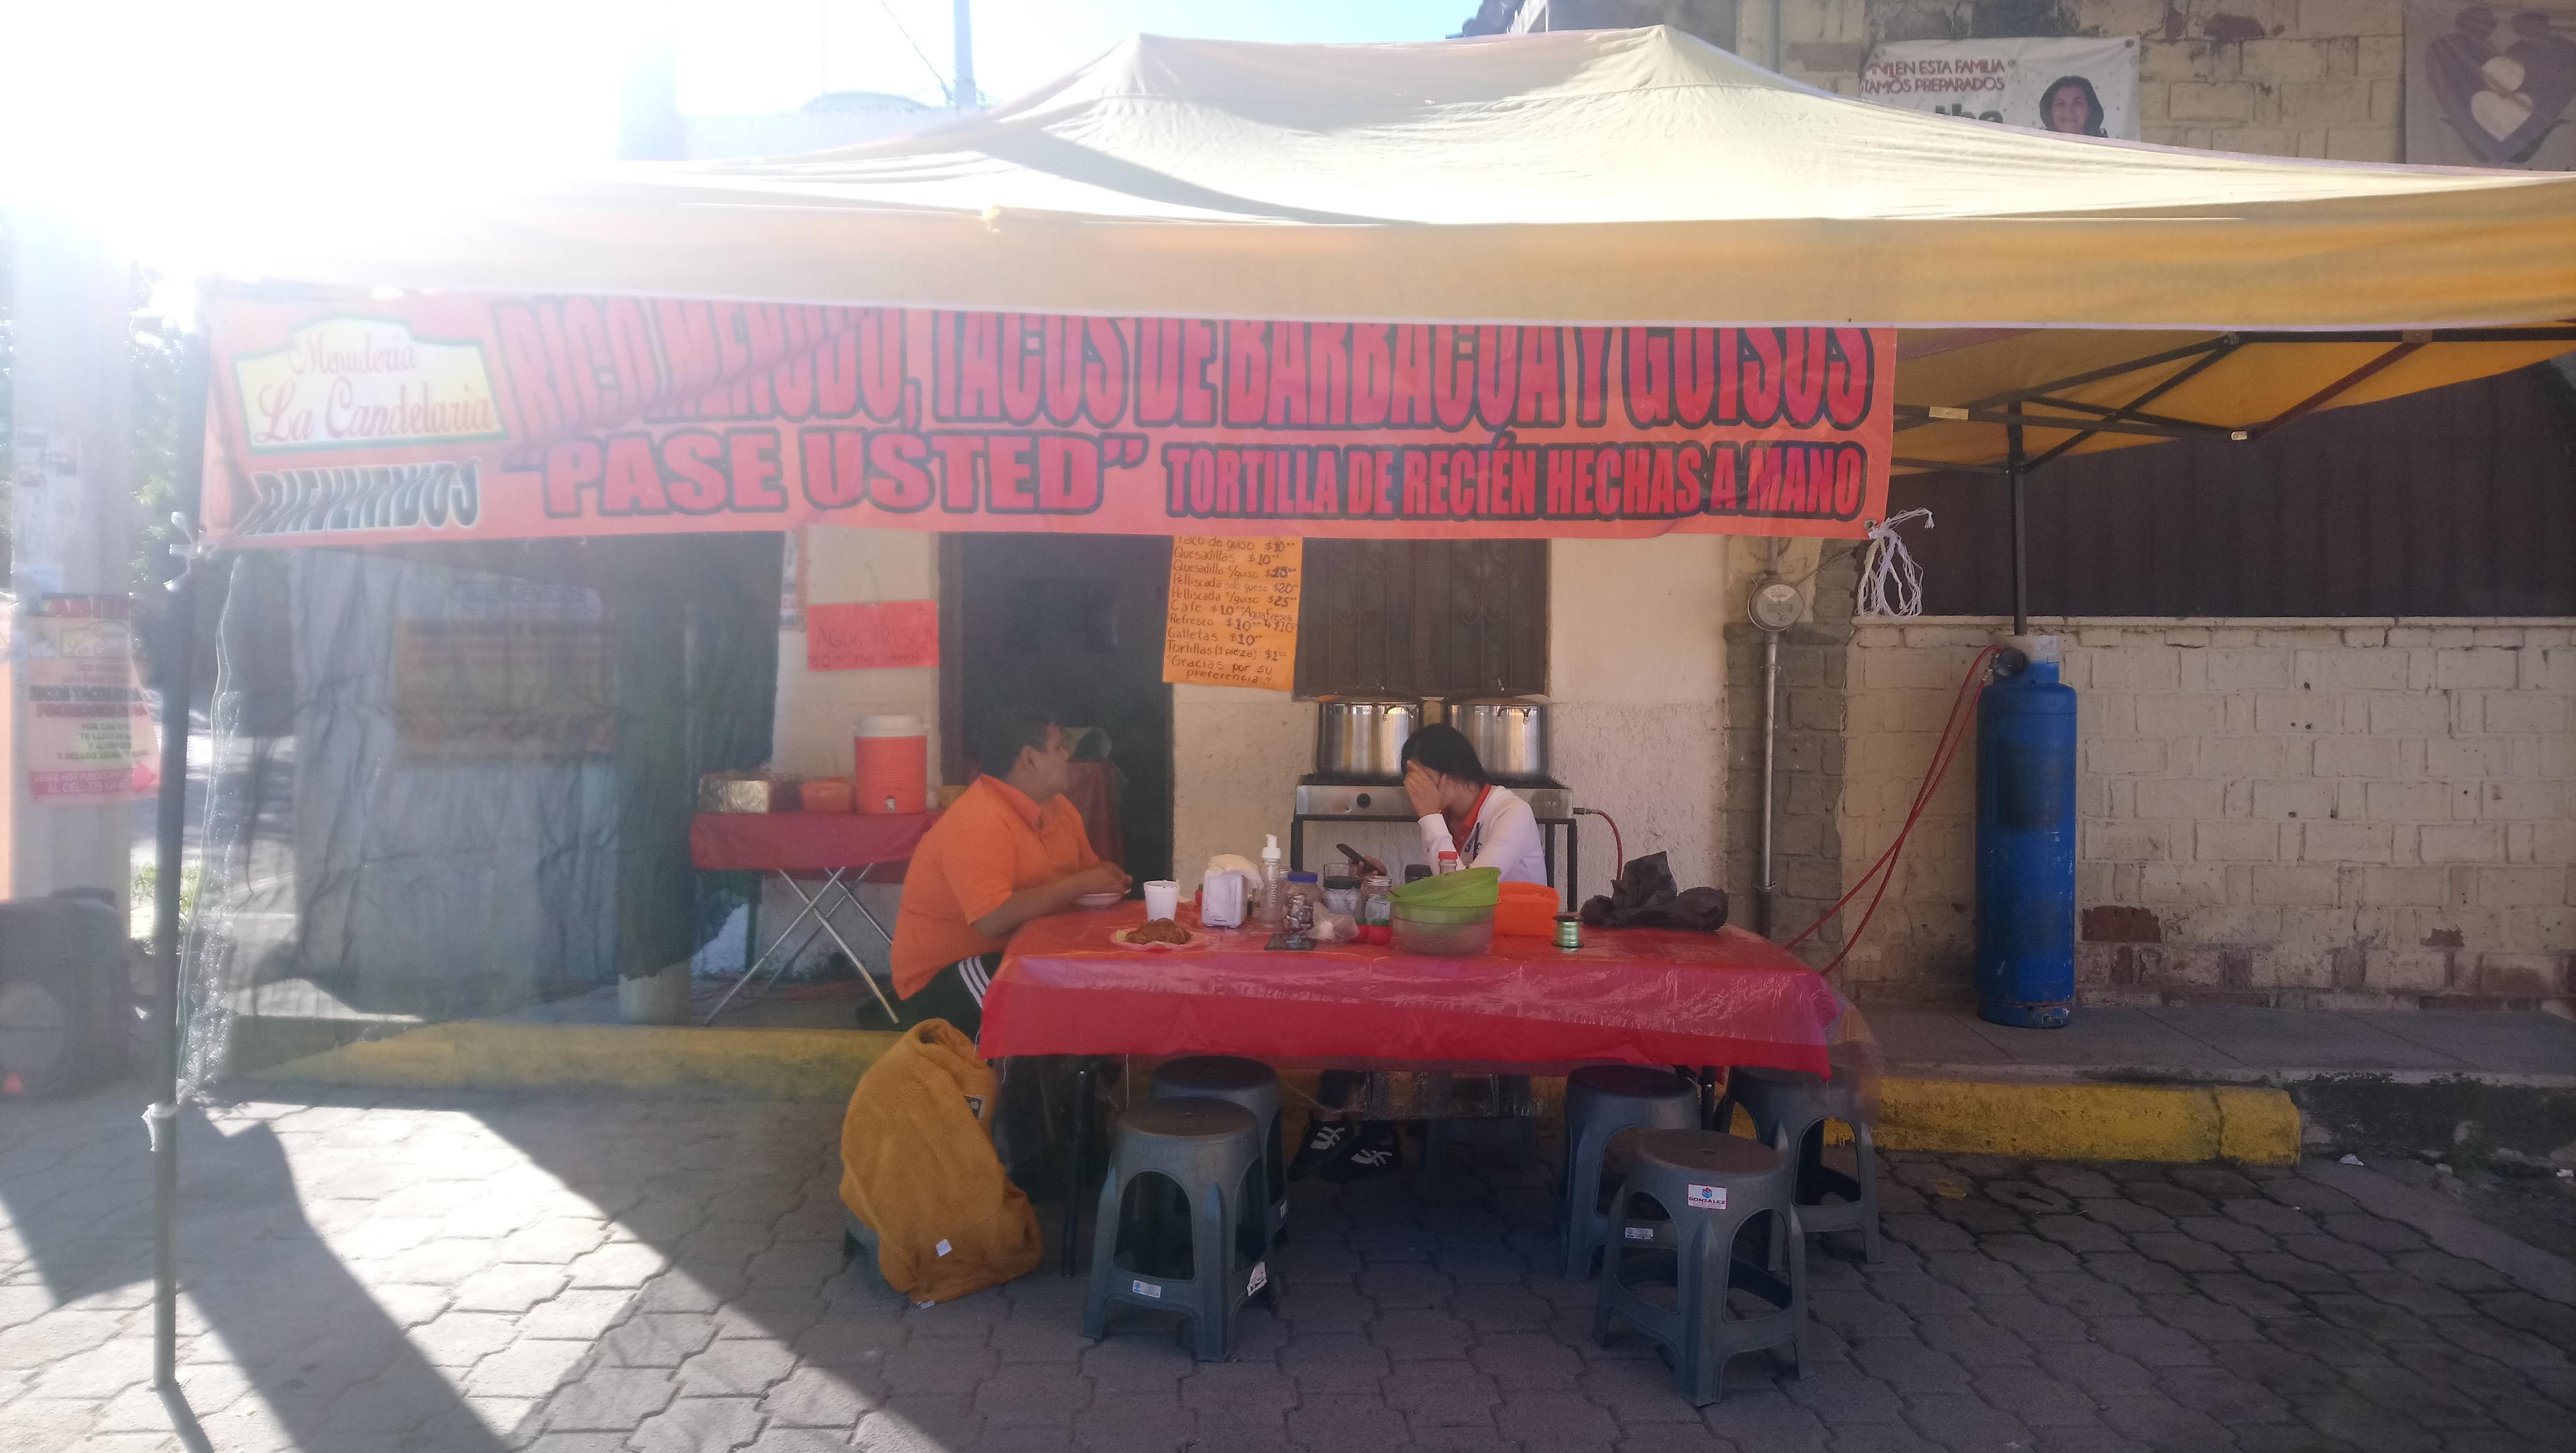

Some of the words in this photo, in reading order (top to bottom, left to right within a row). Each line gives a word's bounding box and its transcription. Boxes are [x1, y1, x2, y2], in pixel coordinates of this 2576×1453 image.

[1919, 60, 1952, 74] ESTA
[1954, 59, 2005, 74] FAMILIA
[1914, 77, 2005, 92] PREPARADOS
[932, 310, 1128, 428] TACOS
[1133, 317, 1218, 428] DE
[1574, 325, 1612, 428] Y
[254, 379, 313, 443] La
[324, 376, 492, 439] Candelaria
[1161, 442, 1343, 519] TORTILLA
[1342, 444, 1397, 520] DE
[1397, 430, 1541, 521] RECIÉN
[1543, 440, 1709, 521] HECHAS
[1706, 441, 1743, 516] A
[1742, 441, 1869, 522] MANO
[1209, 536, 1222, 547] de
[1226, 539, 1254, 552] guiso
[1174, 545, 1235, 563] Quesadillas
[1173, 572, 1221, 588] Pelliscada
[1172, 586, 1221, 601] Pelliscada
[1171, 600, 1202, 612] Cafe
[1170, 612, 1214, 626] Refresco
[1168, 626, 1218, 641] Galletas
[1167, 640, 1212, 654] Tortillas
[1232, 663, 1251, 673] por
